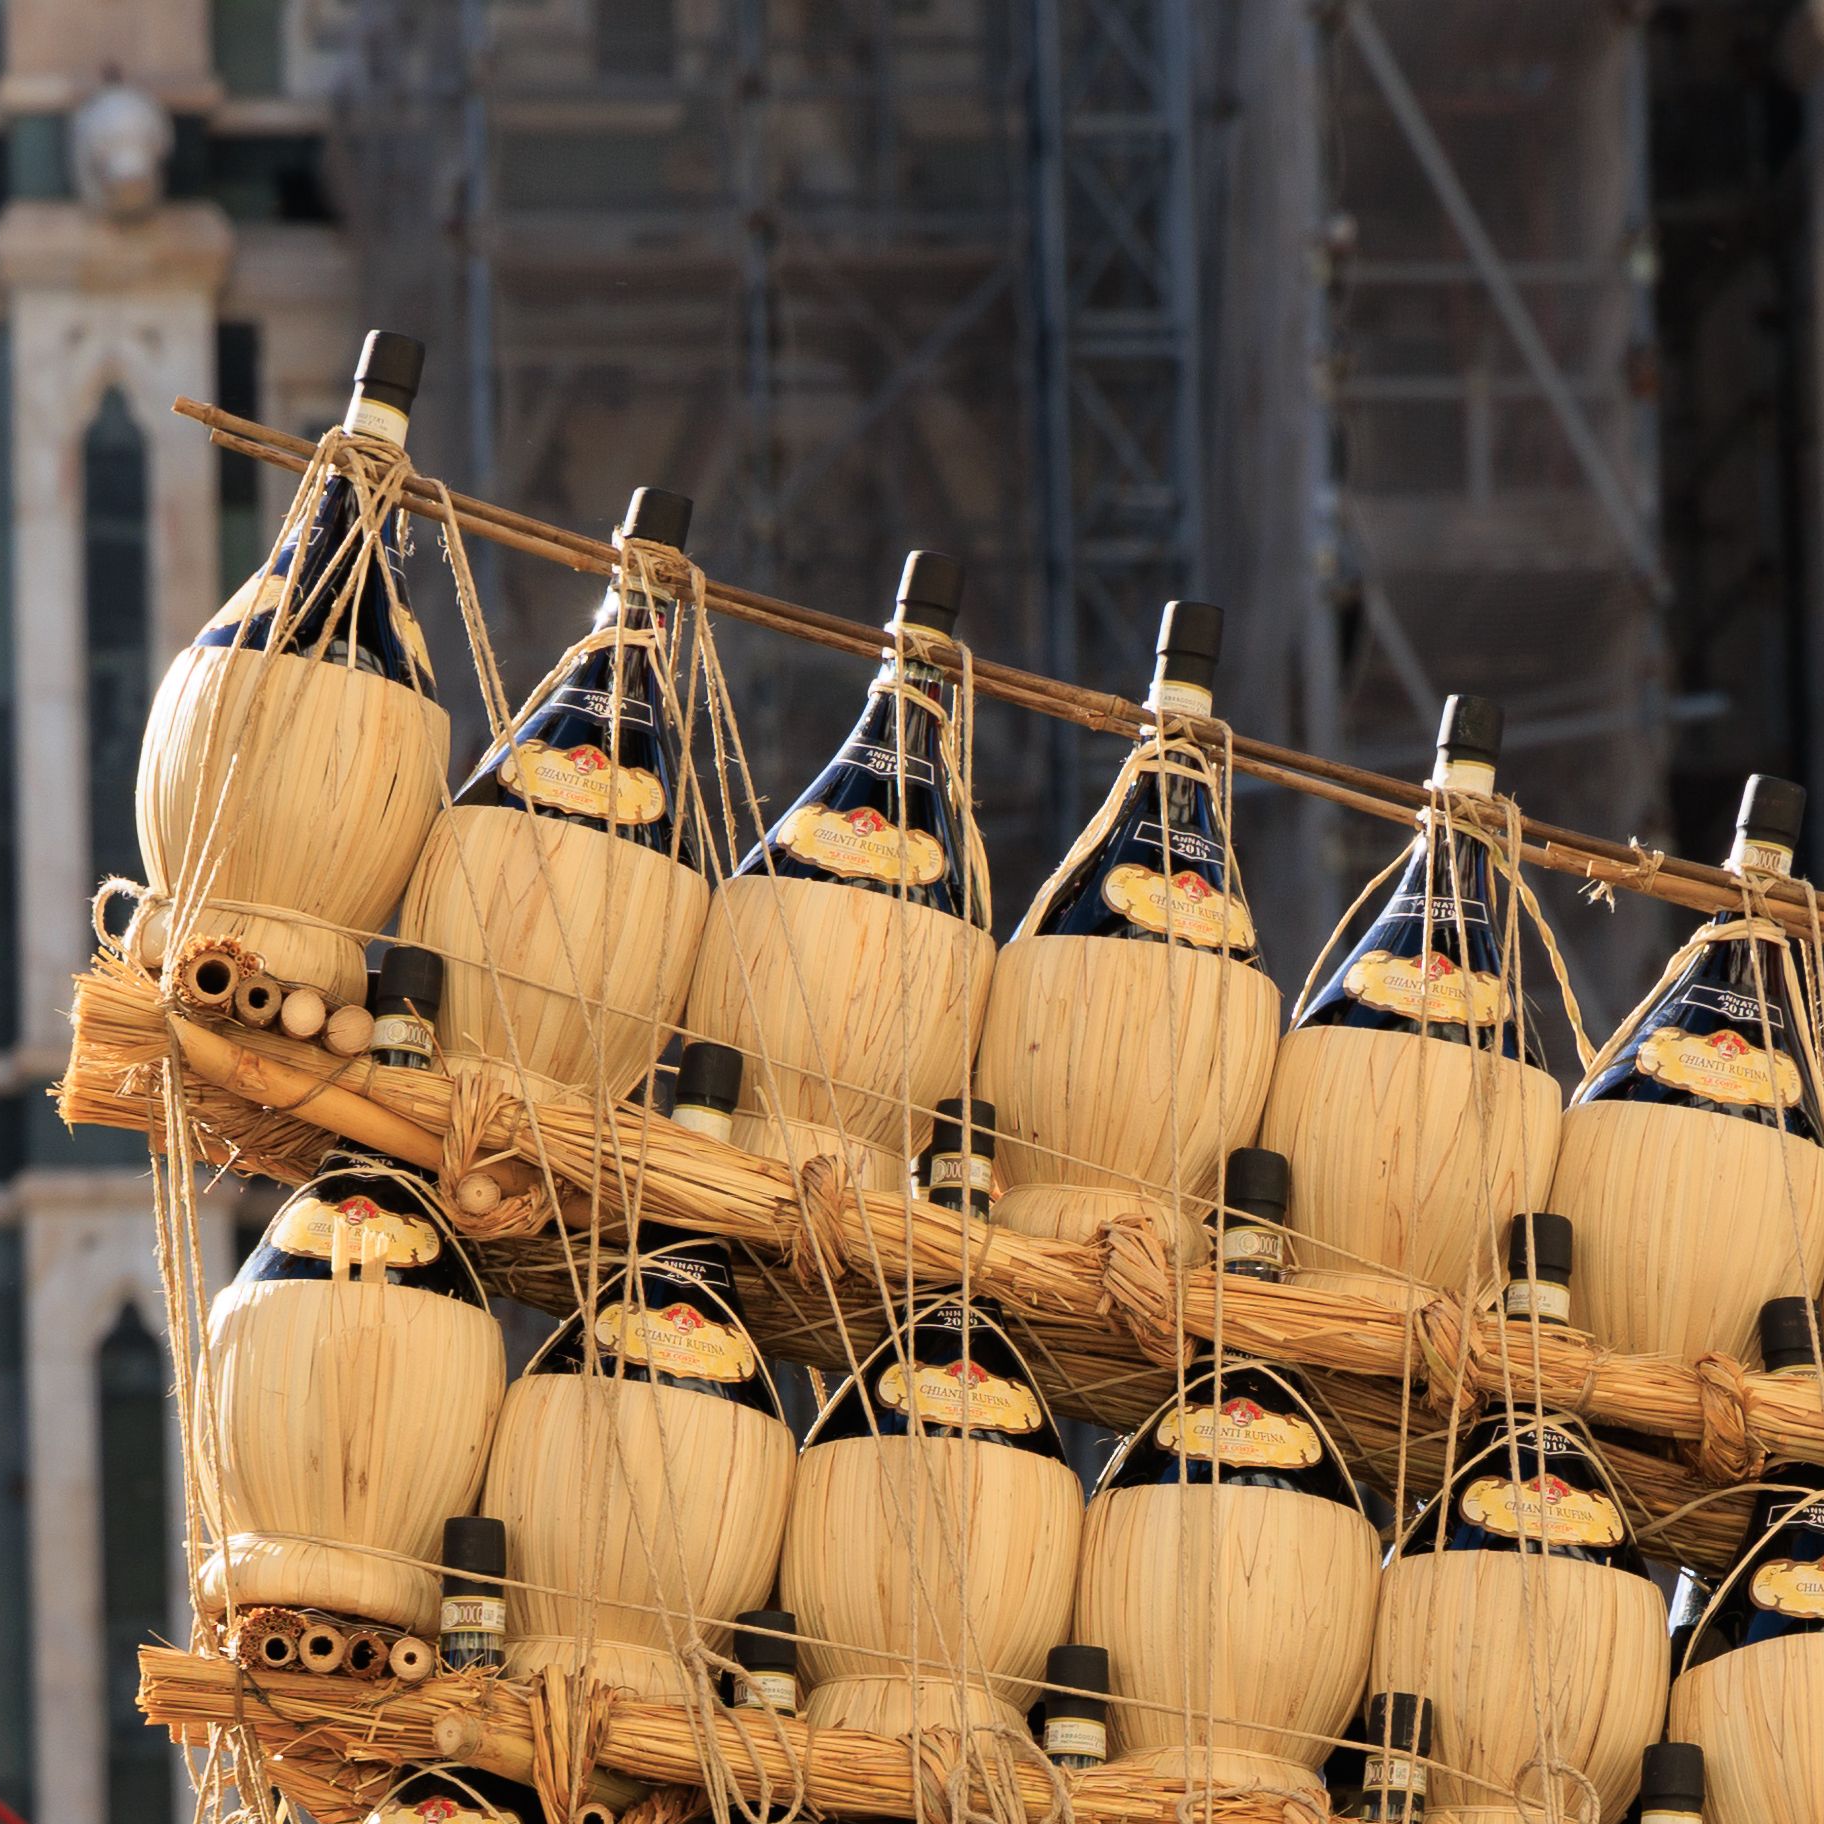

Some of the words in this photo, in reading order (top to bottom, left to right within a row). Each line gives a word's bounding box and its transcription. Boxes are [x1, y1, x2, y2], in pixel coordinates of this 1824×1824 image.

[535, 764, 581, 786] CHIANTI
[582, 779, 623, 798] RUFIA
[814, 827, 859, 848] CHIANTI
[1150, 892, 1195, 915] CHANTI
[1720, 1001, 1755, 1019] 2019
[1678, 1052, 1727, 1072] CHIANTI
[1728, 1064, 1768, 1083] RUFINA
[943, 1317, 979, 1327] 209
[685, 1338, 725, 1357] RUFINA
[921, 1383, 963, 1401] CHIANT
[971, 1393, 1010, 1408] RUFINA
[1193, 1423, 1242, 1438] CHINTI
[1244, 1430, 1287, 1444] RUFINA
[1556, 1507, 1594, 1523] RUFINA
